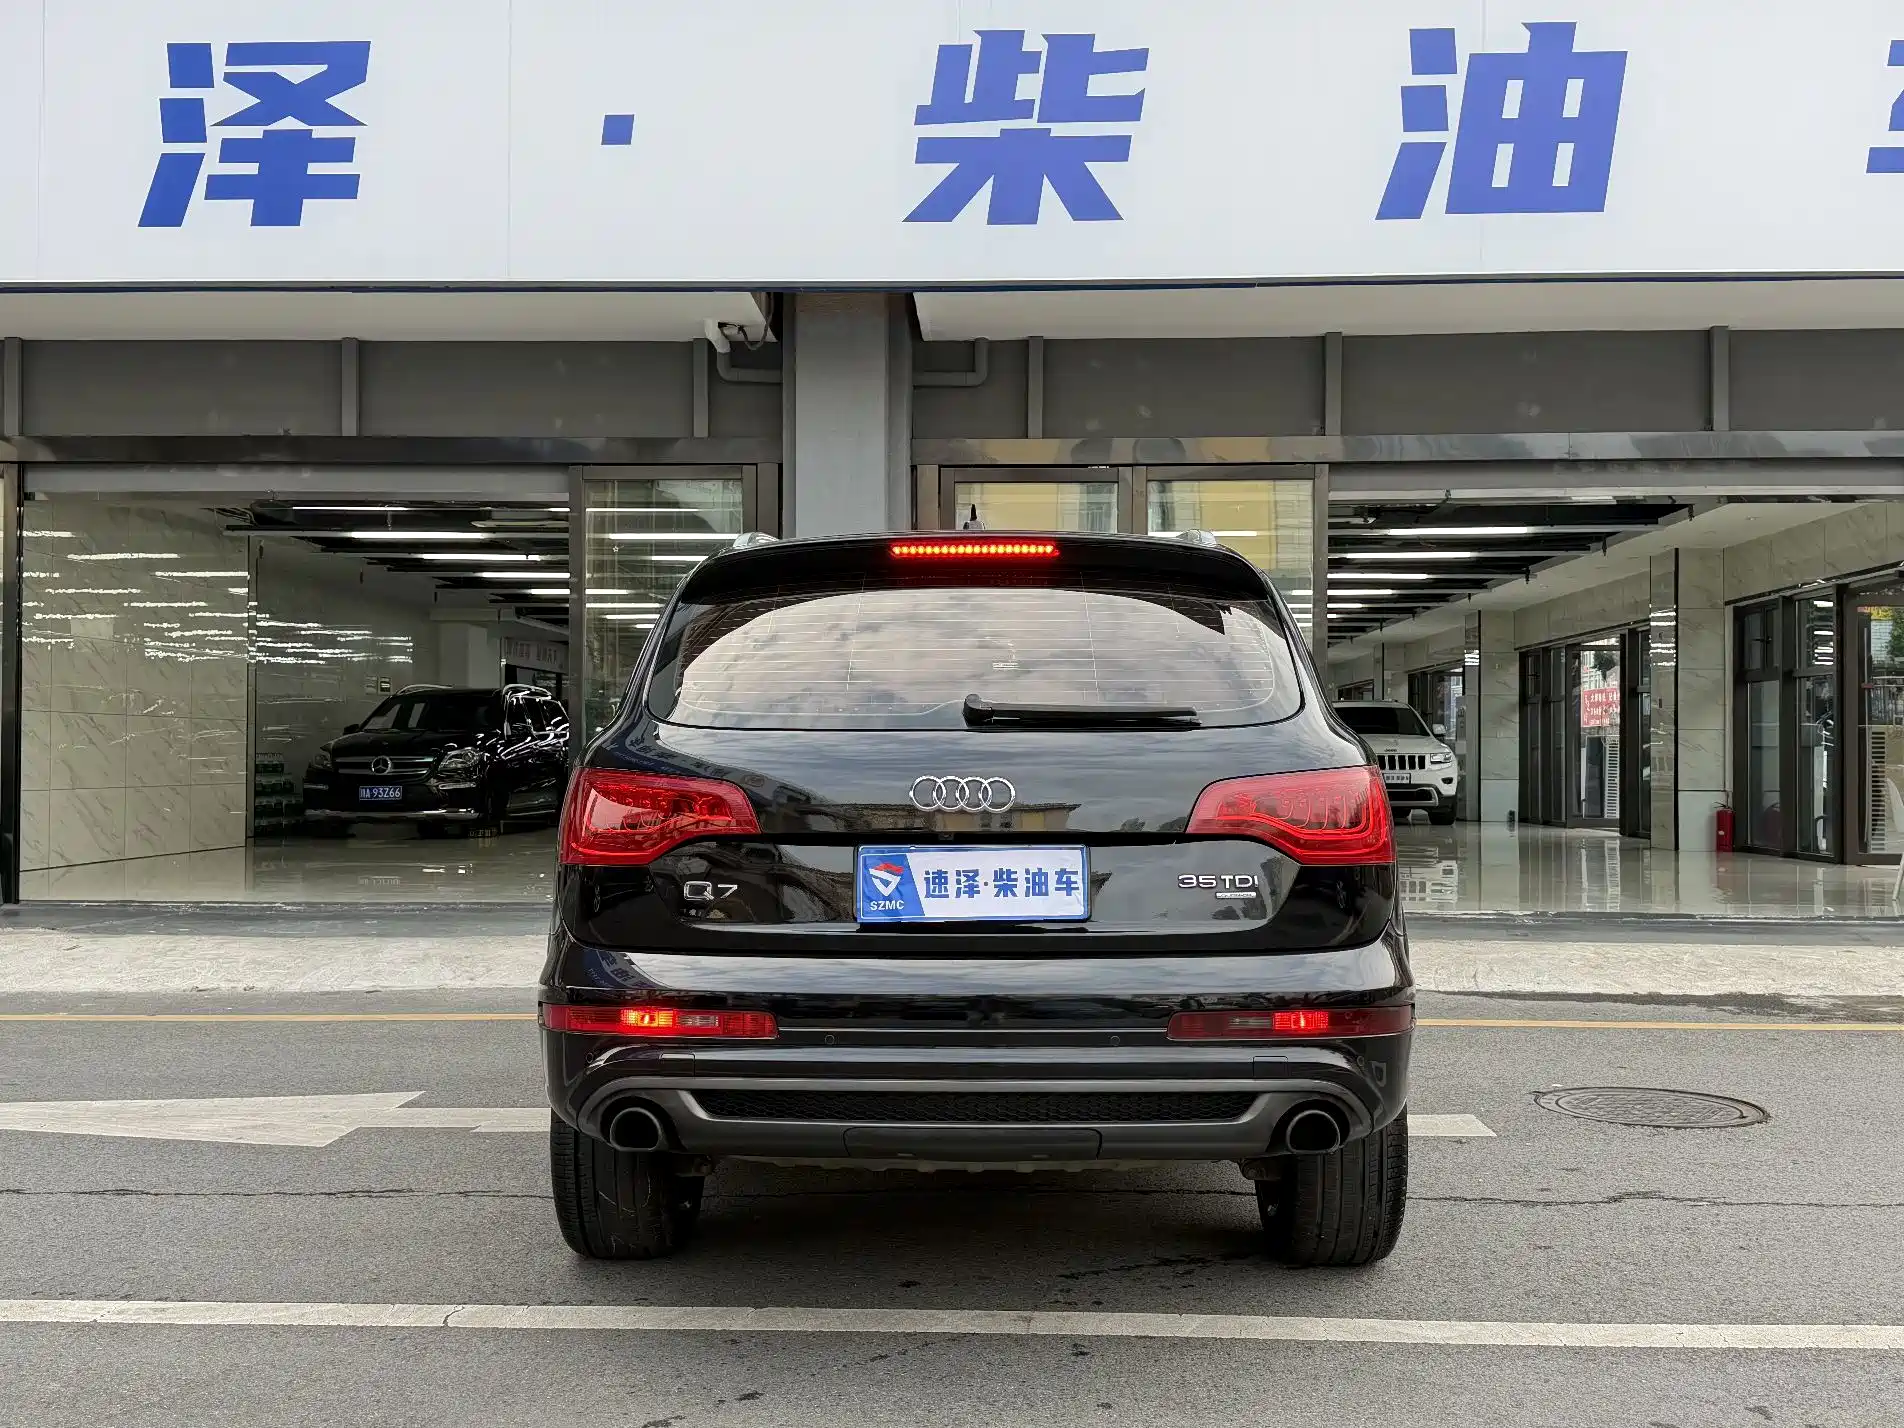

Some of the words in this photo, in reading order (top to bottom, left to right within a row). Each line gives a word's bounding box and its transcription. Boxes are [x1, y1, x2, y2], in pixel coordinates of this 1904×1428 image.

[138, 22, 1904, 227] 泽·柴油
[684, 881, 738, 901] Q7
[924, 867, 1080, 899] 速泽·柴油车
[1178, 874, 1217, 888] 35
[1220, 874, 1259, 889] TDI
[870, 900, 905, 911] SZMC
